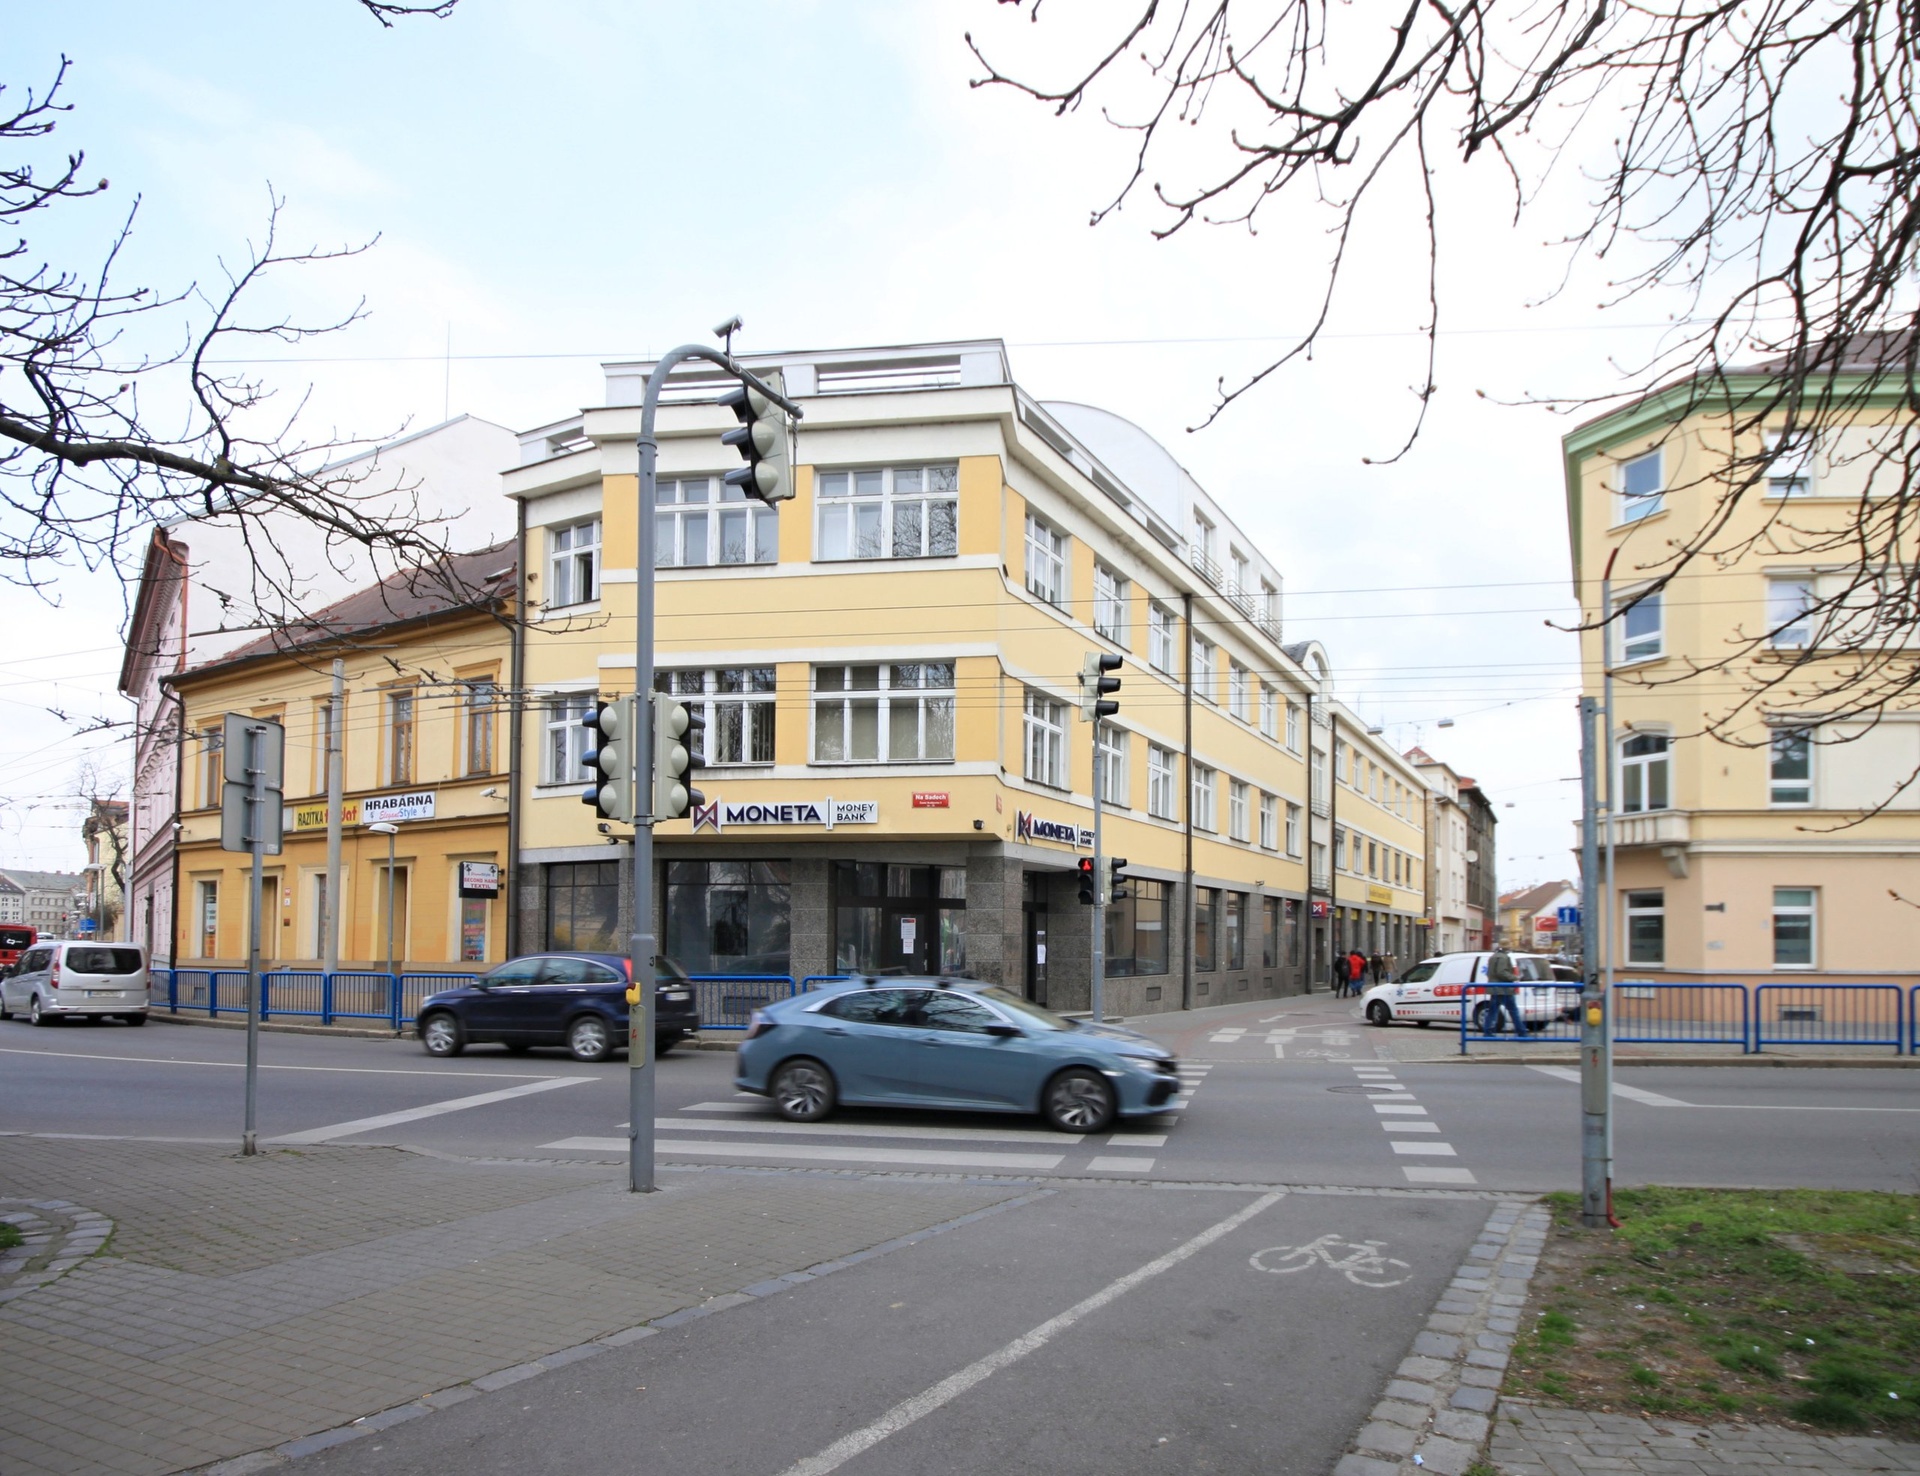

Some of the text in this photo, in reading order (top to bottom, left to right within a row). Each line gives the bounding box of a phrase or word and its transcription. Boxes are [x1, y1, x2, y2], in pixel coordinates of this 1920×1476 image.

[365, 794, 433, 811] HRABÁRNA
[837, 803, 875, 812] MONEY
[298, 807, 323, 826] RAZÍTKA
[726, 805, 821, 822] MONETA
[837, 813, 866, 821] BANK
[1034, 819, 1076, 842] MONETA
[650, 956, 654, 967] 3
[1589, 973, 1599, 985] 2
